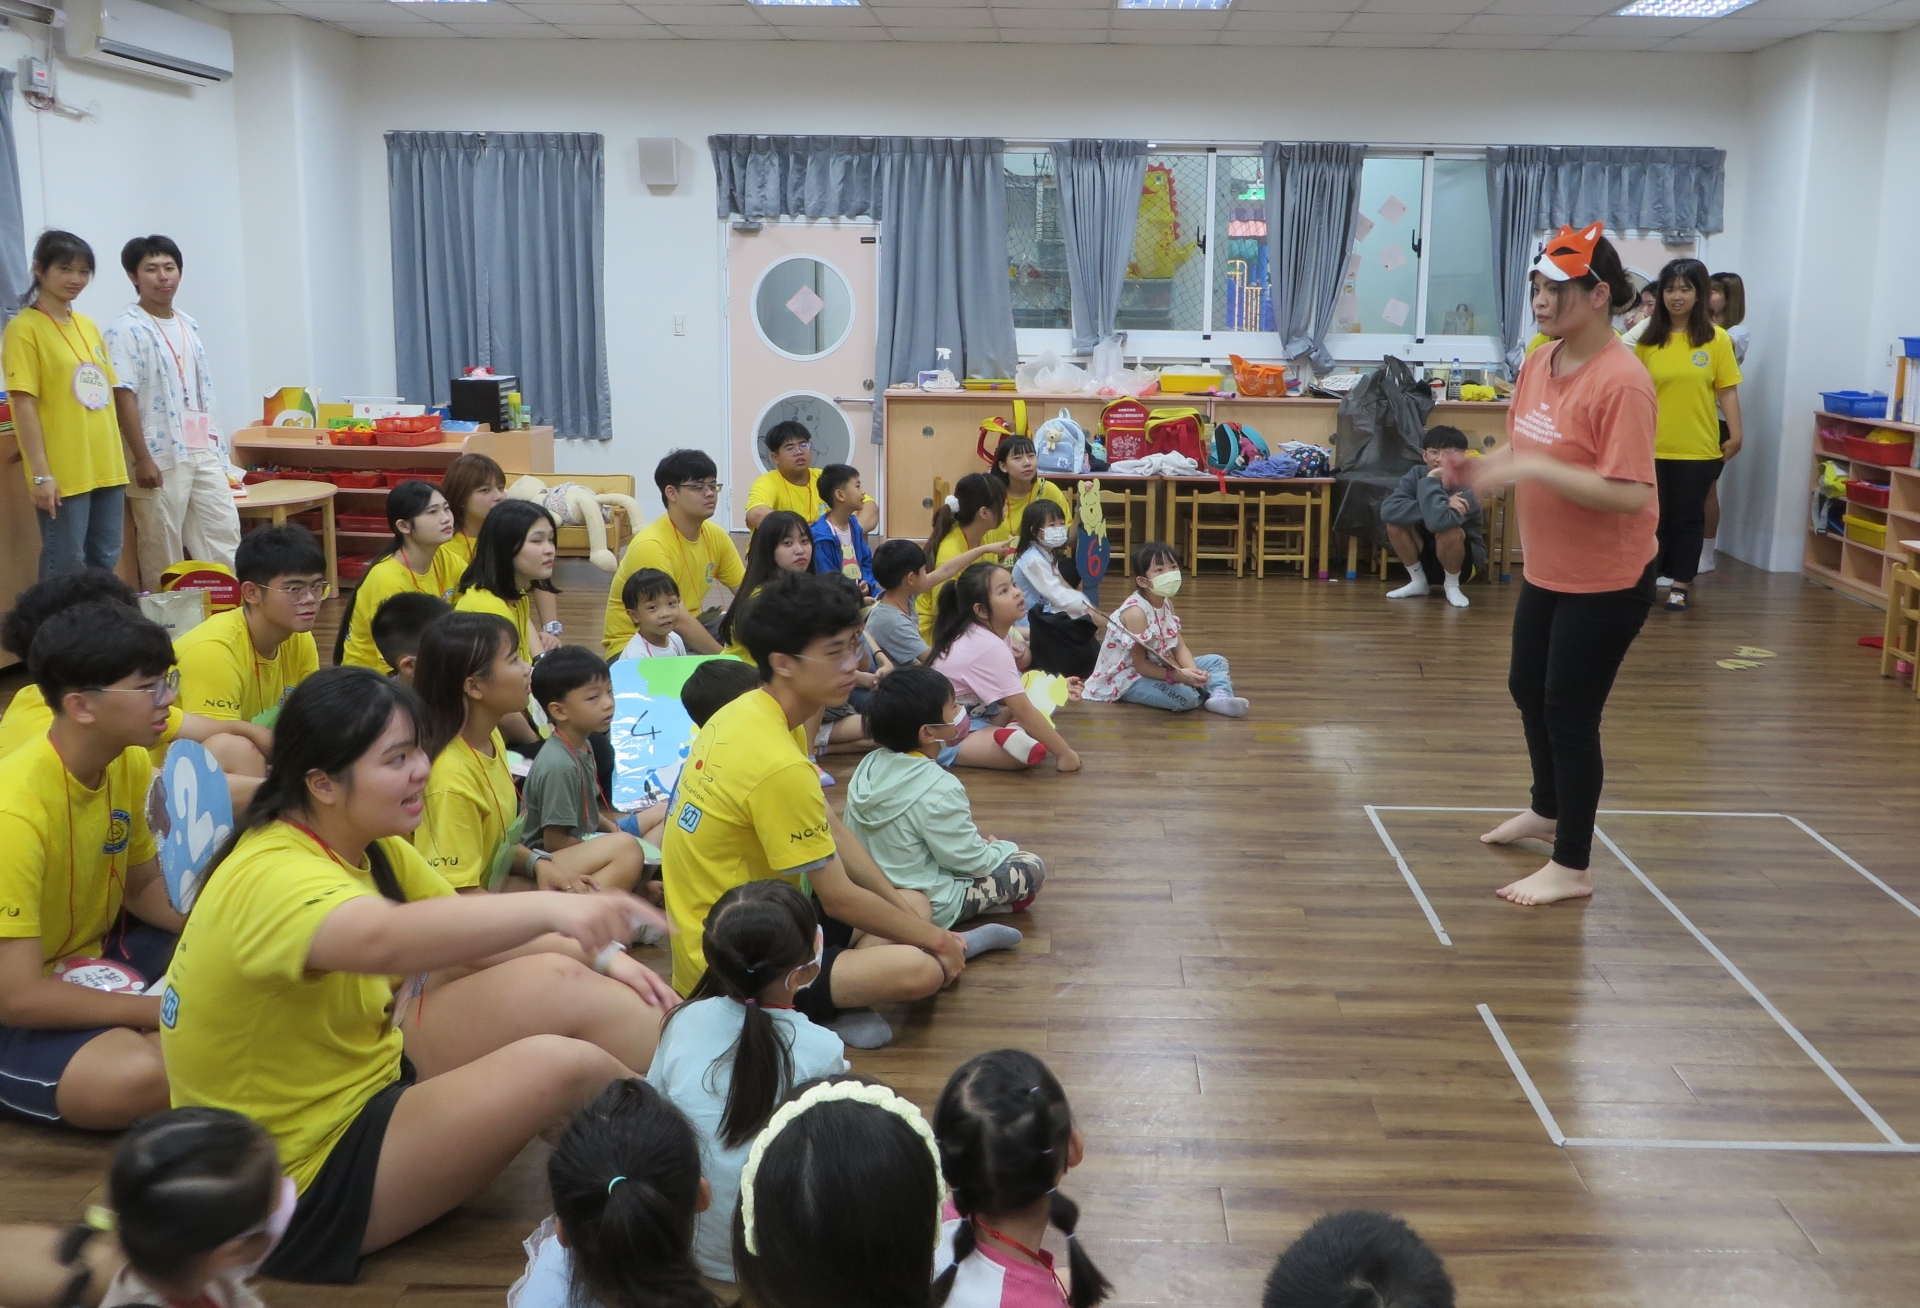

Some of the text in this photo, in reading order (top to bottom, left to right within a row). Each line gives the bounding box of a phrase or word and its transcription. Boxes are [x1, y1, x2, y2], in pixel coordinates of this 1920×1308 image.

[1087, 539, 1101, 577] 6
[631, 710, 662, 740] 4
[173, 756, 214, 864] 2
[680, 805, 698, 828] 幼
